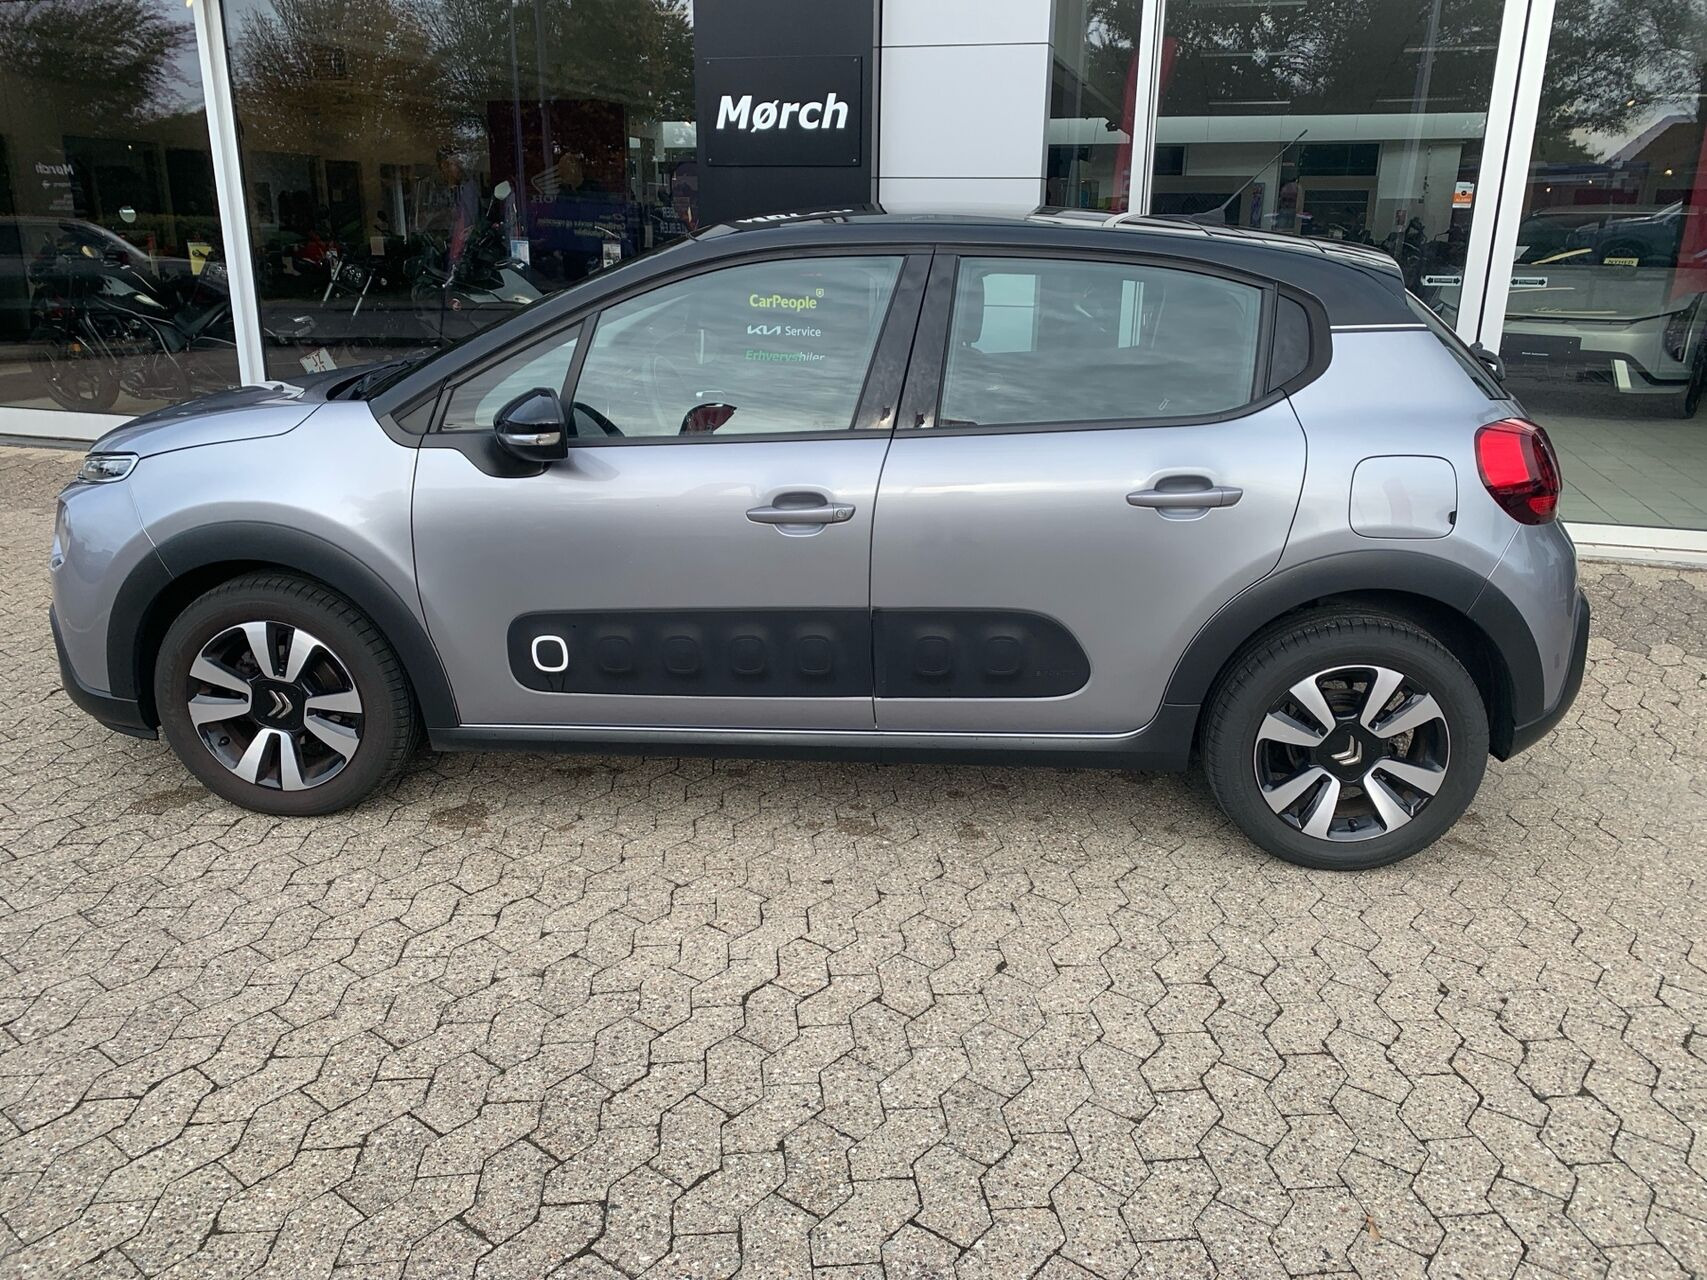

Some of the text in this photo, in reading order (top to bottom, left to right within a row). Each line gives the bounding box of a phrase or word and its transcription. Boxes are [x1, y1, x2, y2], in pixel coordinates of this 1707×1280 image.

[715, 92, 849, 133] Mørch
[749, 293, 818, 312] CarPeople
[785, 325, 822, 337] Service
